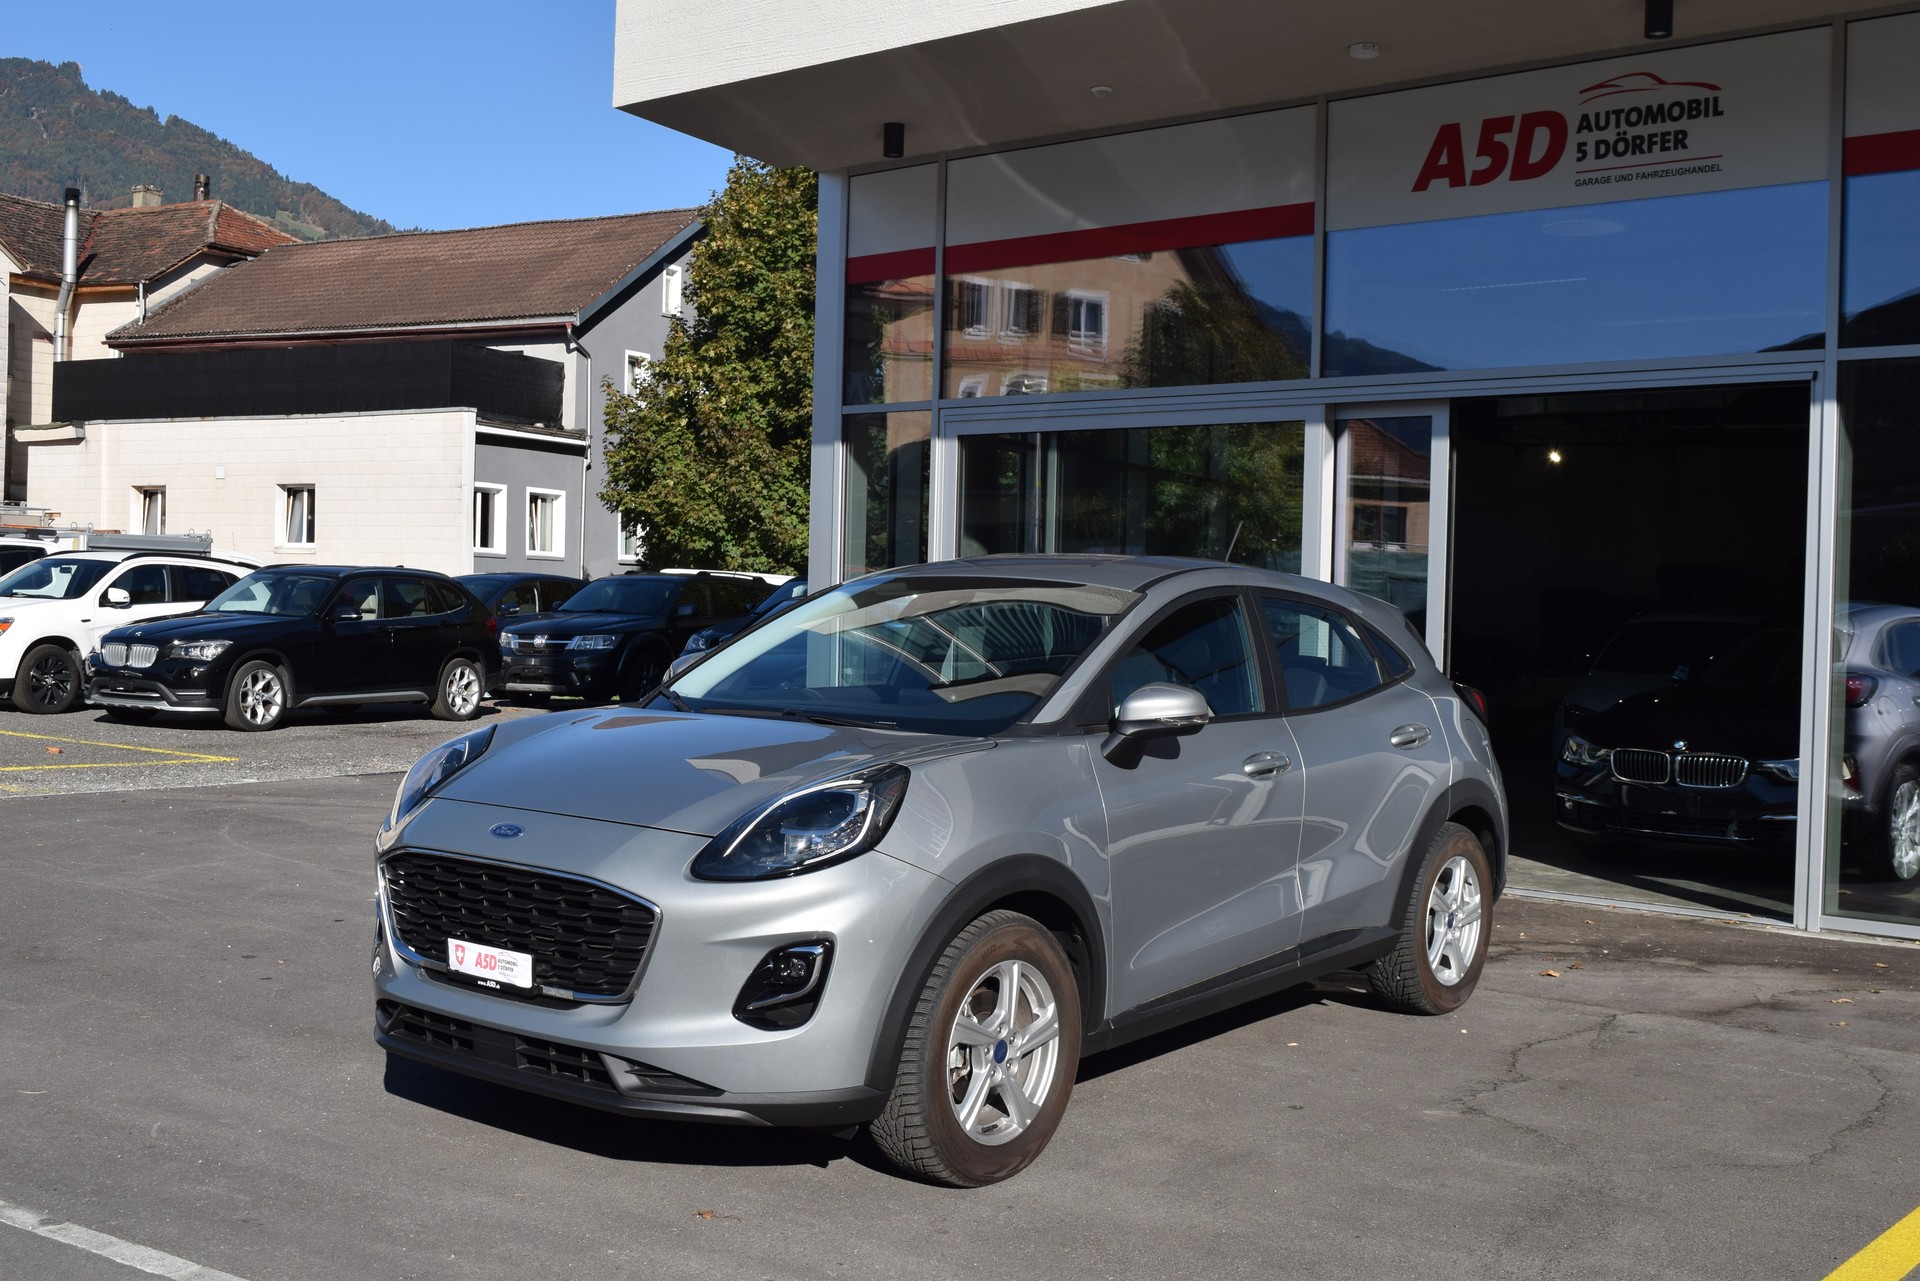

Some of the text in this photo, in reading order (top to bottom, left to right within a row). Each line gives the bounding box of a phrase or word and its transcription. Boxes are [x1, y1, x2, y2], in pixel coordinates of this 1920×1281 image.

[1576, 96, 1724, 134] AUTOMOBIL
[1411, 110, 1568, 192] A5D
[1576, 130, 1689, 162] 5 DÖRFER
[1574, 163, 1723, 187] GARAGE UND FAHRZEUGHANDEL
[475, 952, 498, 971] A5D
